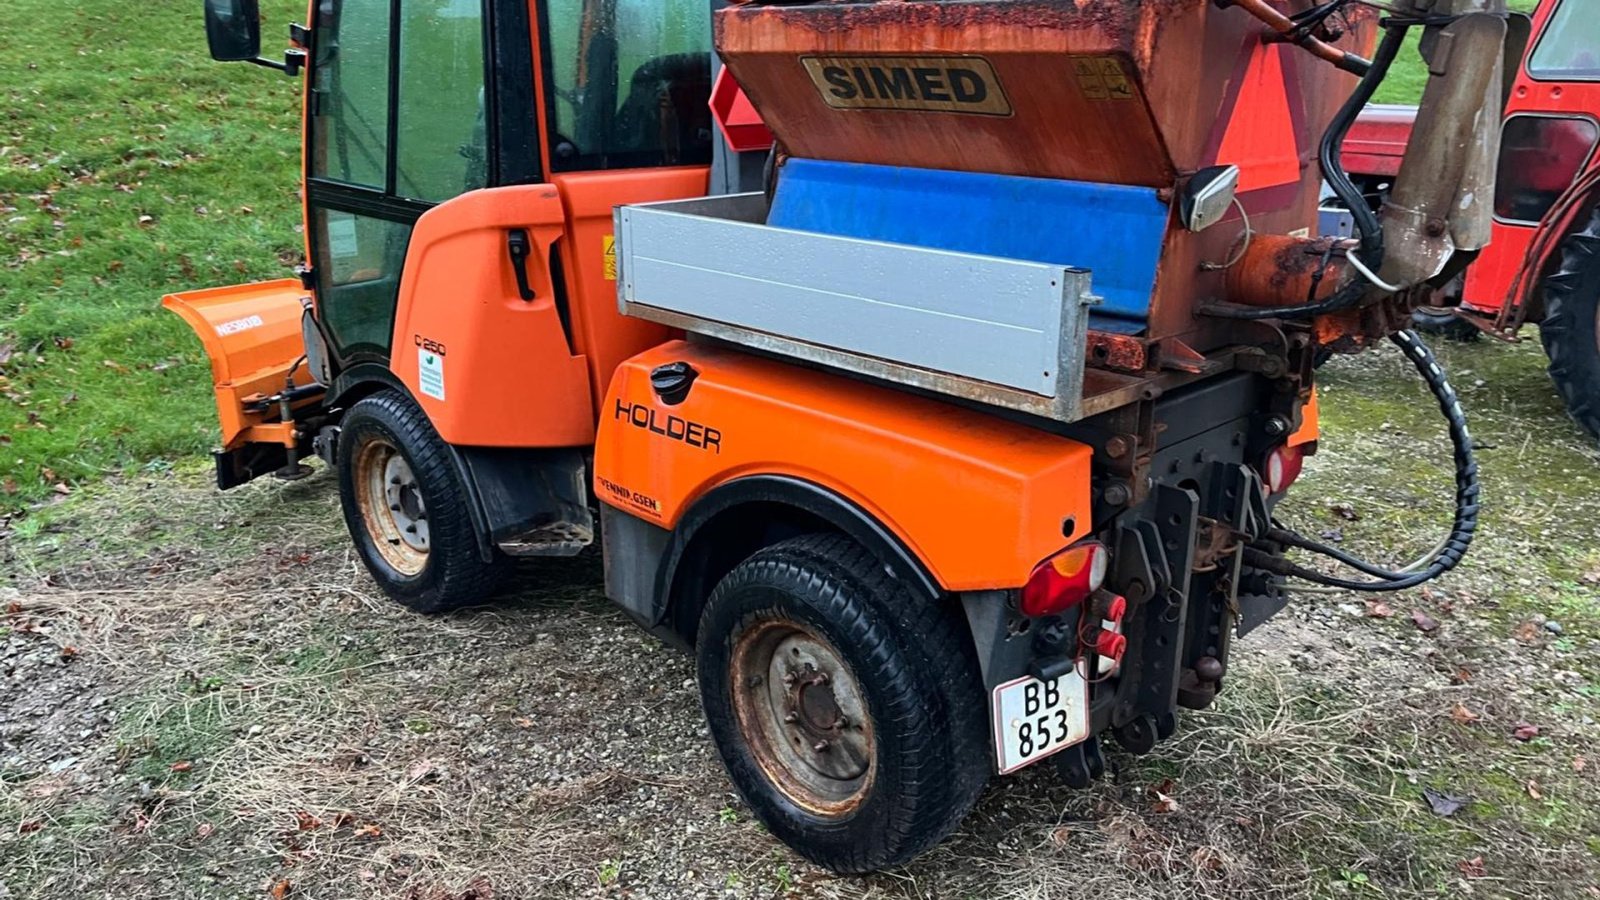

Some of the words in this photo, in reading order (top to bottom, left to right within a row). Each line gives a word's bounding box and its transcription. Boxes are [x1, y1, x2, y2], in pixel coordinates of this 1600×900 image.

[823, 66, 987, 103] SIMED
[414, 334, 422, 347] C
[423, 338, 446, 357] 250
[615, 398, 722, 455] HOLDER
[1024, 679, 1060, 717] BB
[1018, 709, 1068, 758] 853
